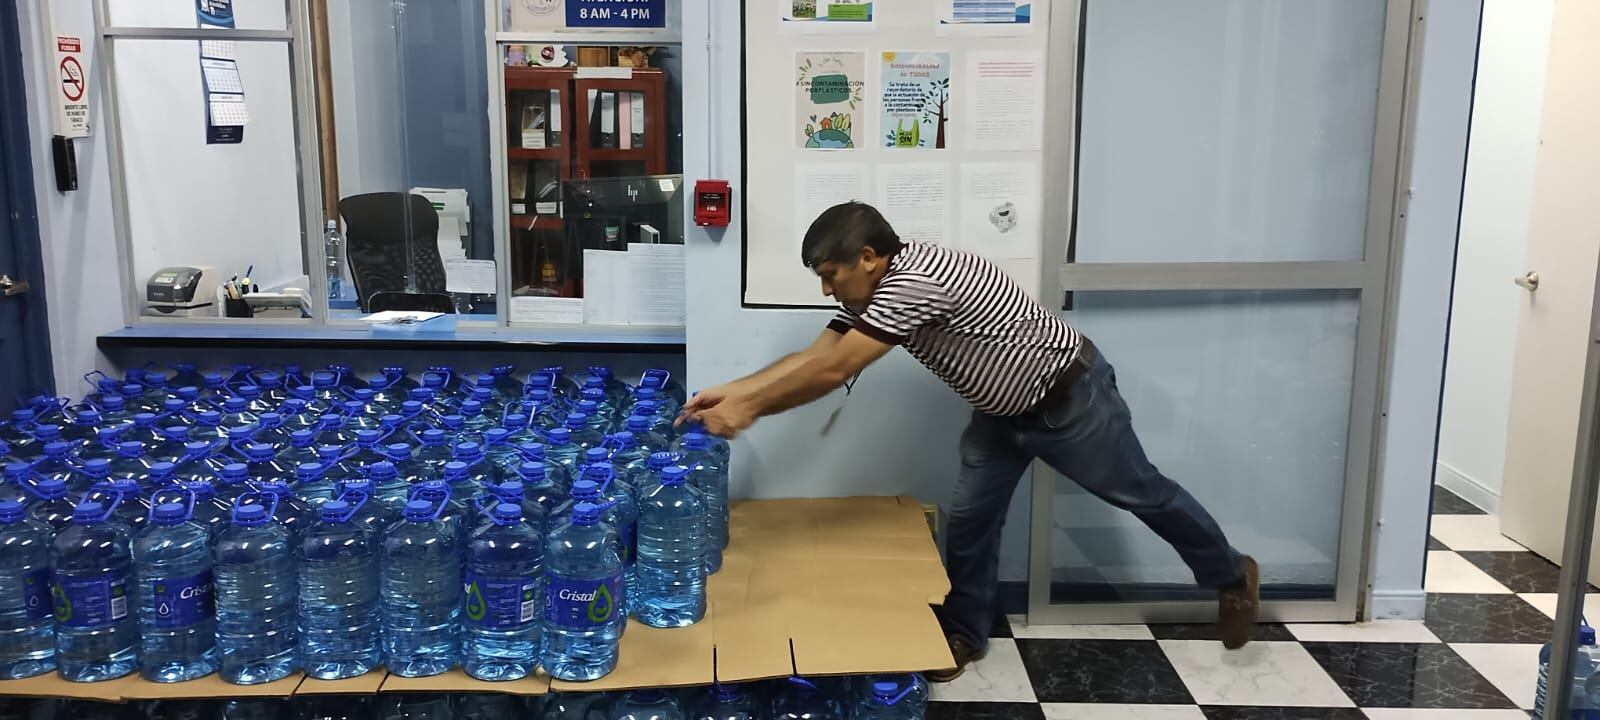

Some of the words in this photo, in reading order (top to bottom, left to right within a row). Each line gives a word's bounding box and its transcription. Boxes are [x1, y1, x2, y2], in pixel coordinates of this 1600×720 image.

[580, 8, 588, 19] 8
[590, 8, 610, 19] AM
[620, 8, 628, 19] 4
[631, 8, 650, 19] PM
[628, 184, 638, 202] hp
[559, 588, 597, 603] Cristal
